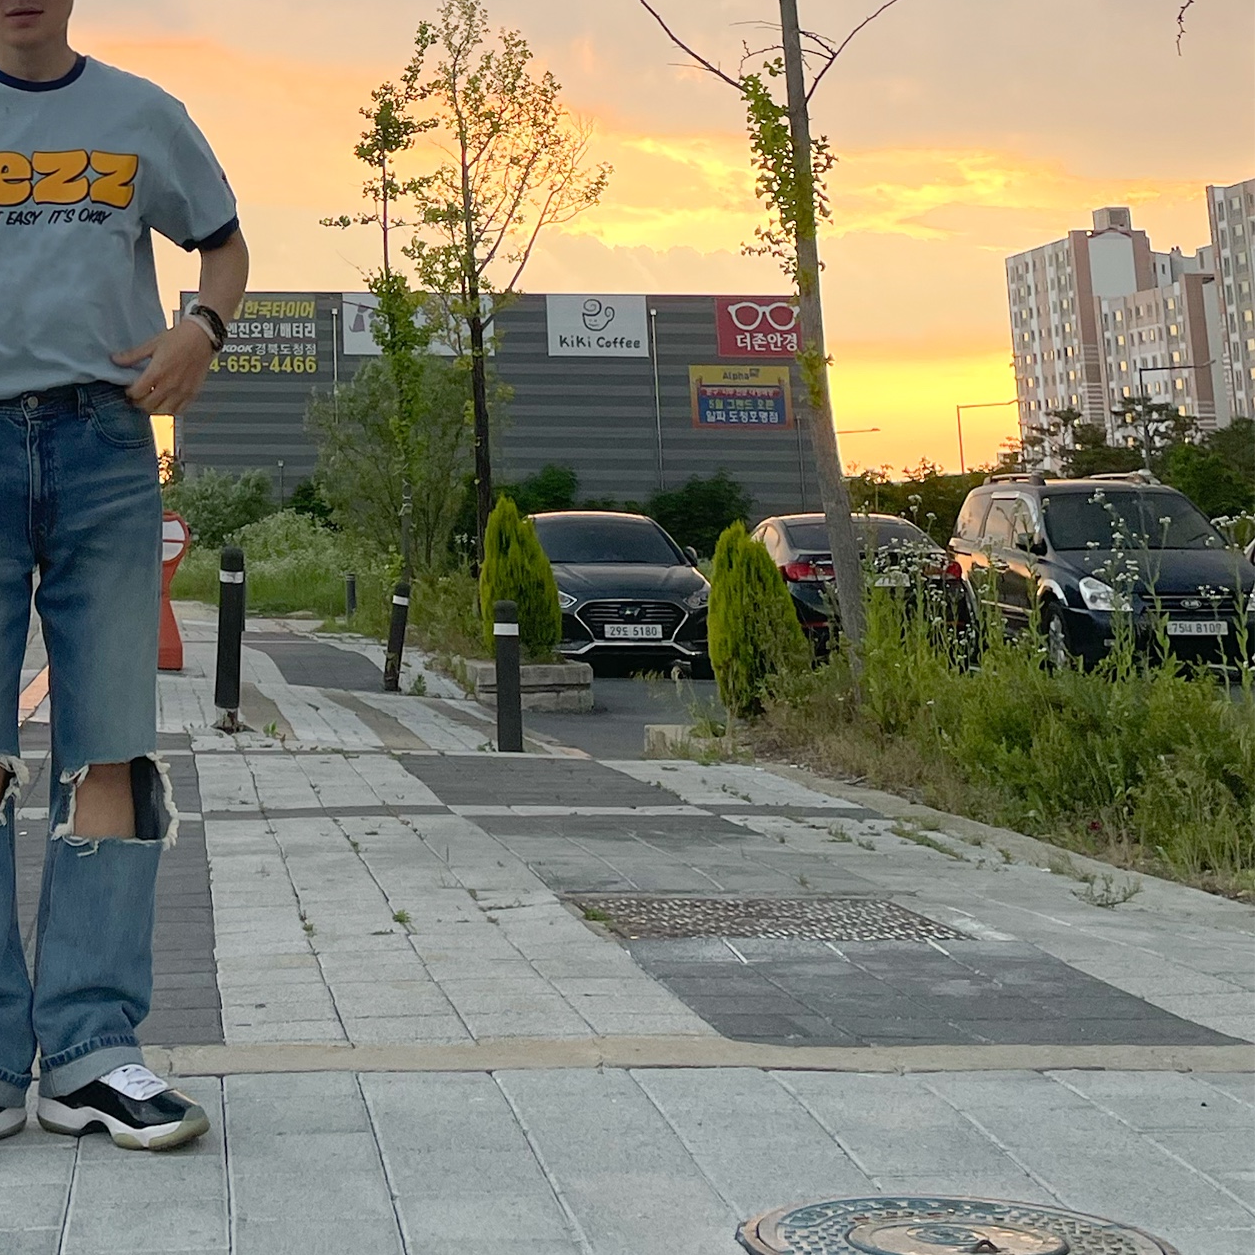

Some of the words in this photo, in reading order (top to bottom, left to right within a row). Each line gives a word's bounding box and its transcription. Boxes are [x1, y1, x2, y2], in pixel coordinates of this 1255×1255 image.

[6, 210, 43, 225] EASY
[48, 209, 75, 224] IT'S
[78, 208, 113, 224] OKAY
[244, 300, 316, 319] 한국타이어
[596, 336, 641, 349] Coffee
[736, 332, 798, 351] 더존안경
[209, 356, 318, 373] 4-655-4466
[722, 371, 750, 381] Alpha
[632, 626, 658, 636] 5180
